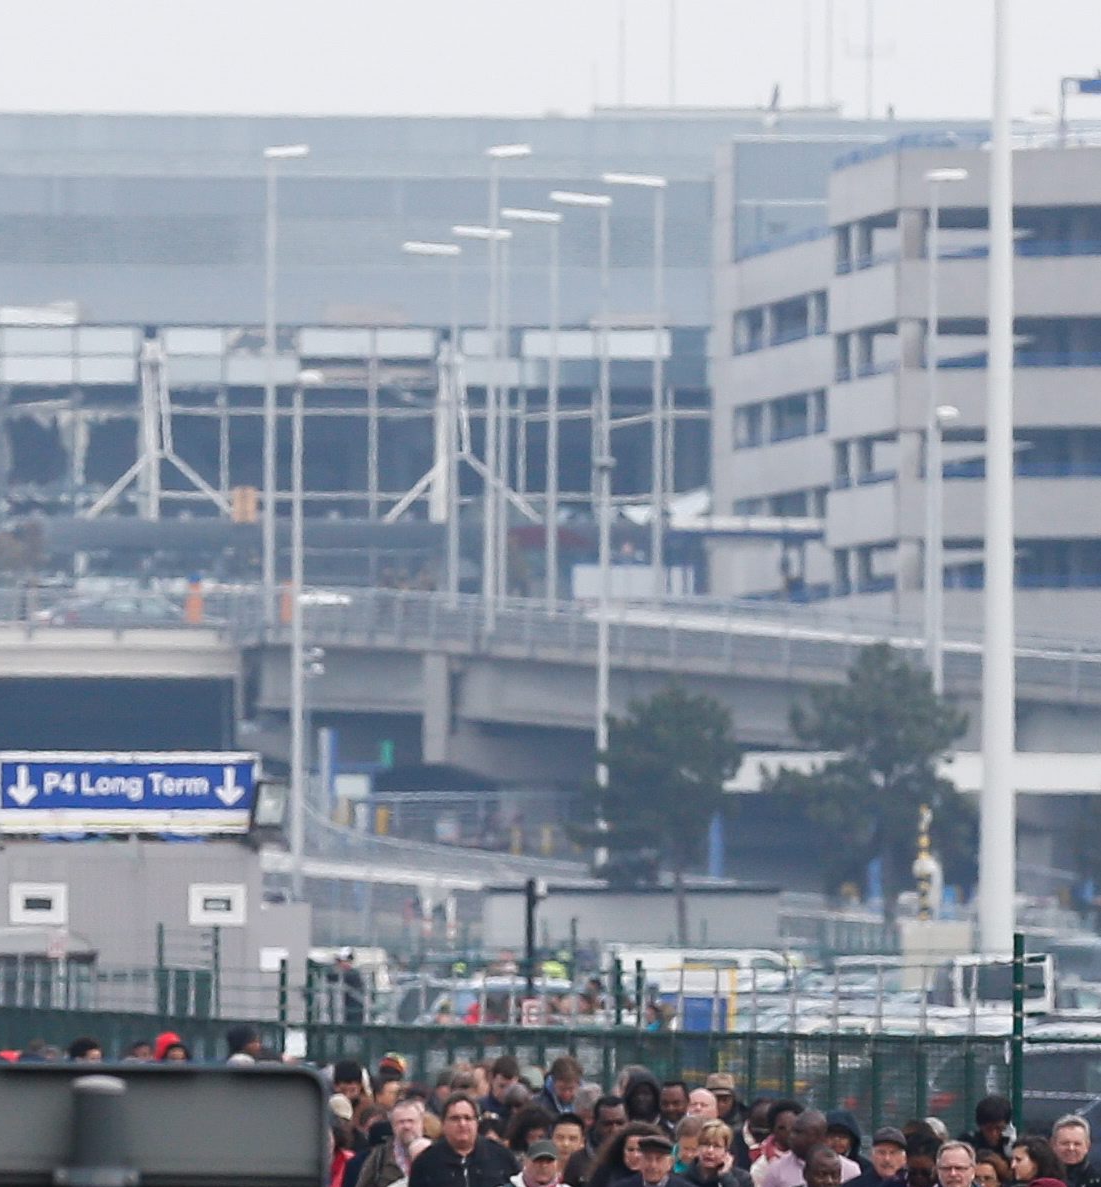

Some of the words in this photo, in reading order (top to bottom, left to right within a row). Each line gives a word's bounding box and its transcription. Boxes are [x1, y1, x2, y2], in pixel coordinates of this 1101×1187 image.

[43, 771, 76, 795] P4
[80, 771, 144, 802] Long
[148, 771, 209, 796] Term
